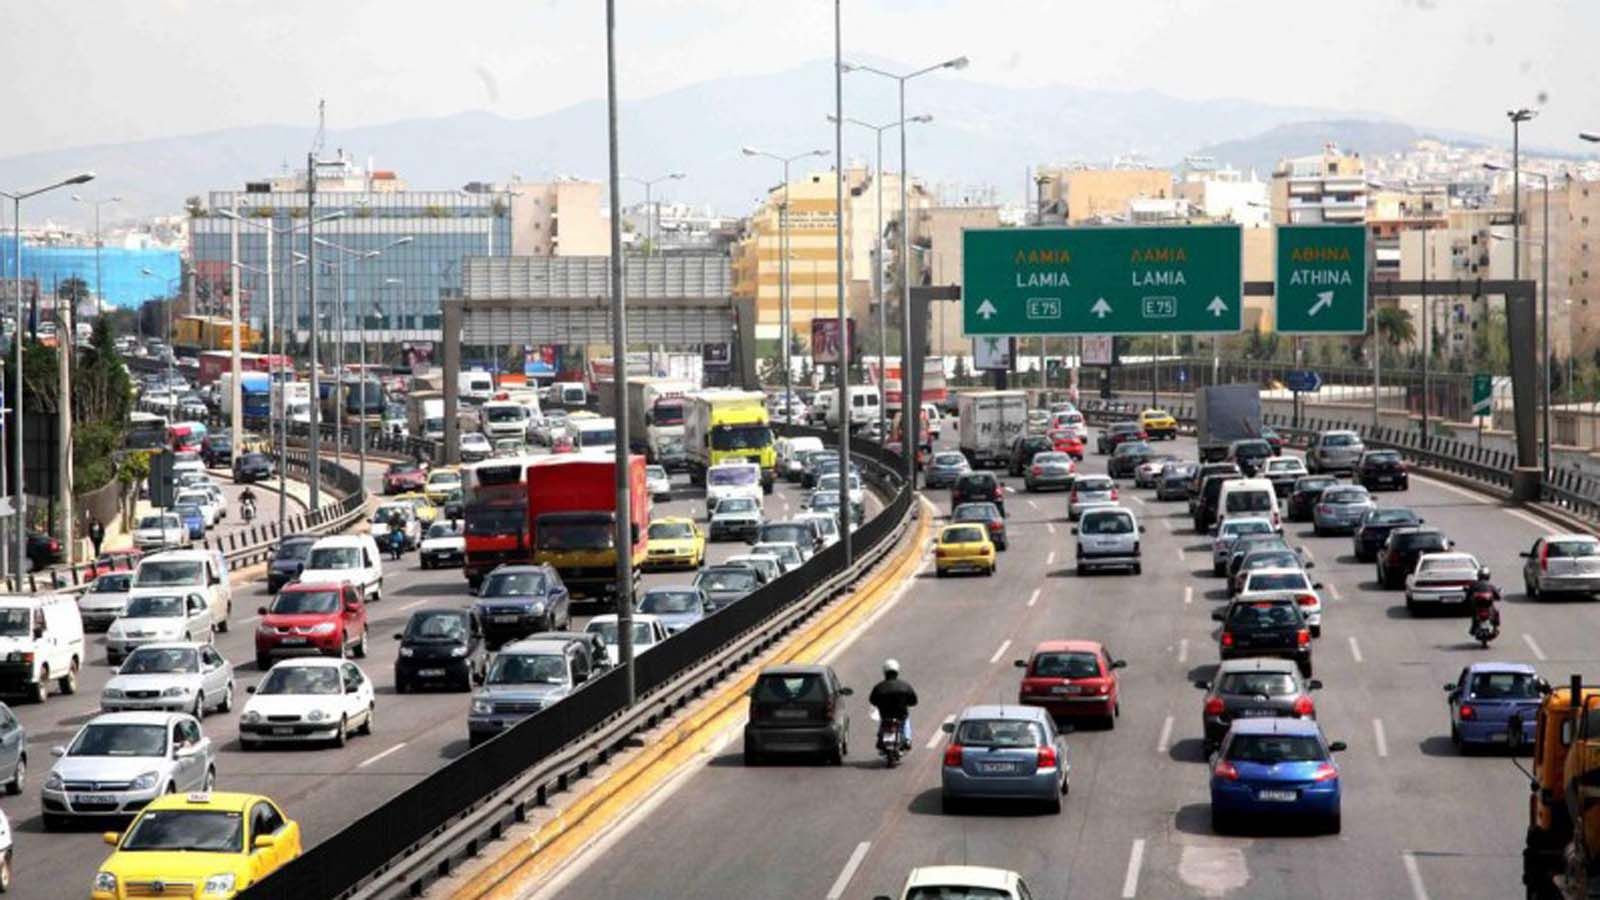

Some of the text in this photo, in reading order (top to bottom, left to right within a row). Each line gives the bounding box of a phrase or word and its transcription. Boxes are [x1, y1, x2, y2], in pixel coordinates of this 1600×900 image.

[1015, 272, 1071, 287] LAMIA
[1131, 271, 1187, 286] LAMIA
[1290, 269, 1352, 285] ATHINA
